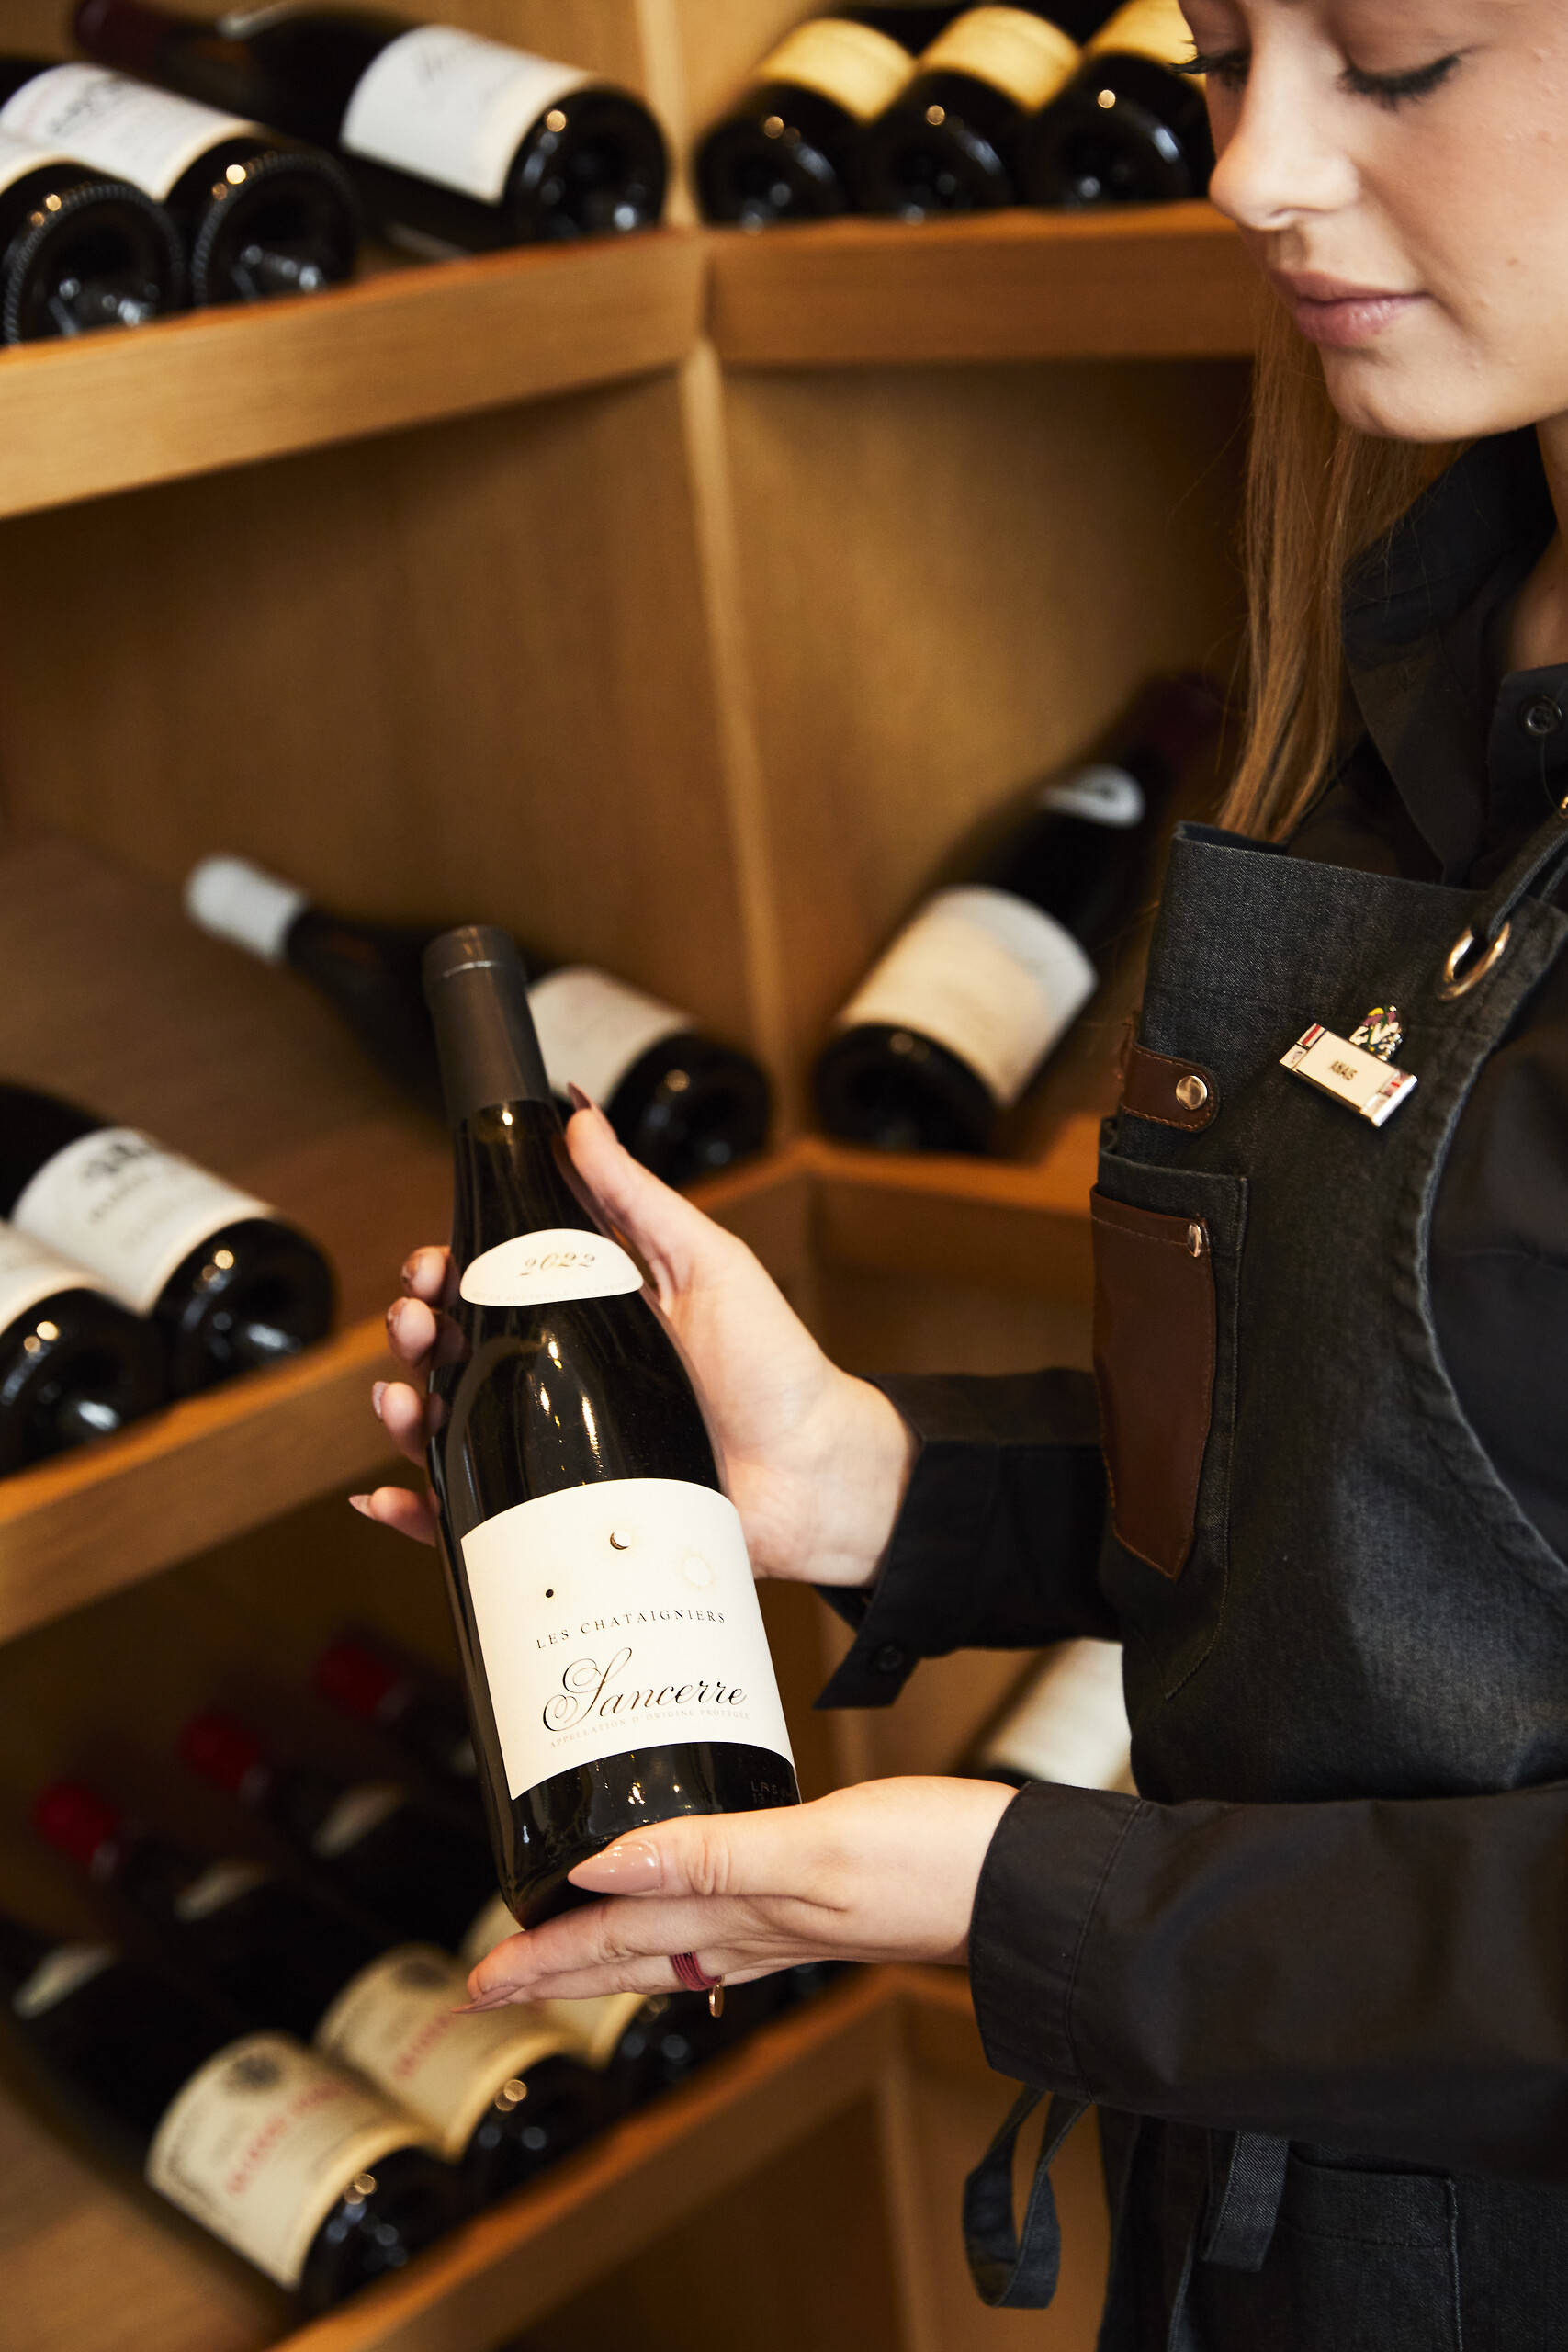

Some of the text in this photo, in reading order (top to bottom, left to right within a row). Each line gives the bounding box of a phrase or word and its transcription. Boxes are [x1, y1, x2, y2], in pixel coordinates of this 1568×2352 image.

[518, 1252, 596, 1277] 2022
[536, 1609, 726, 1650] LES CHATAIGNIERS
[542, 1646, 748, 1733] Sancerre
[550, 1718, 626, 1749] APPELLATION
